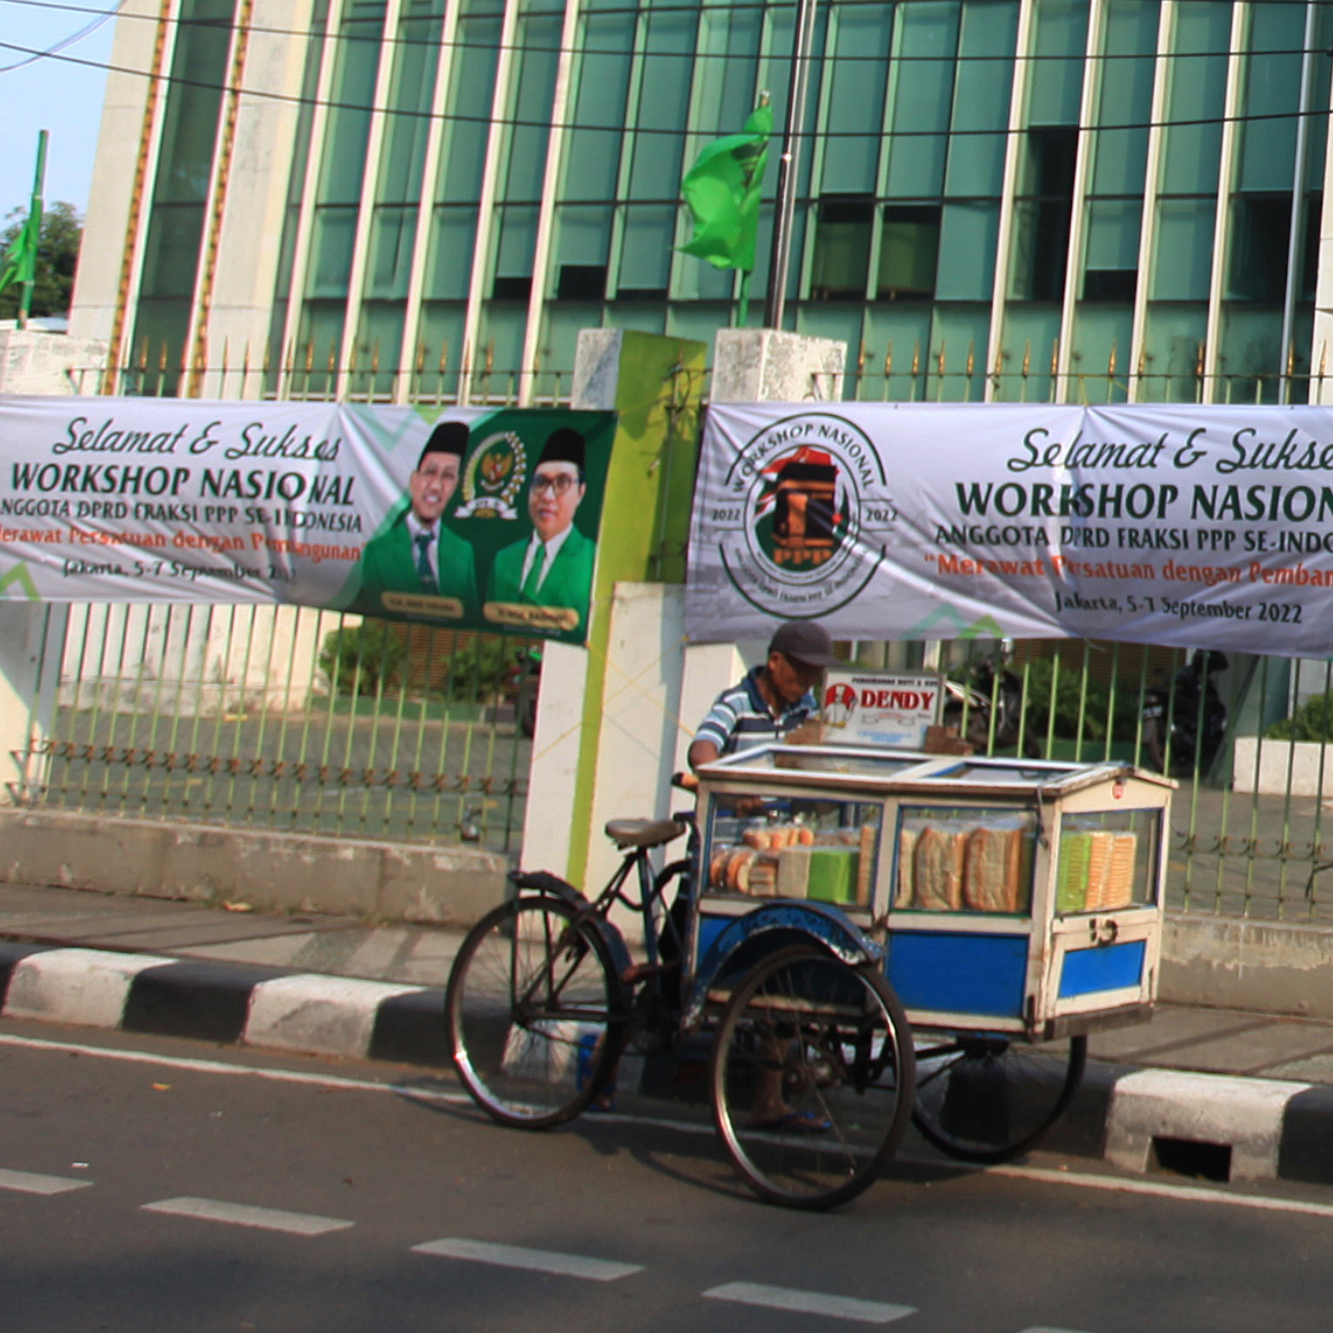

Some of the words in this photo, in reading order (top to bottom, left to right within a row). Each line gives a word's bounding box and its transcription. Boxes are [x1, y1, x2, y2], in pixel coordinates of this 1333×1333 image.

[52, 417, 190, 455] Selamat
[188, 421, 222, 454] &
[224, 422, 342, 461] Sukses
[1007, 428, 1169, 472] Selamat
[1173, 427, 1208, 468] &
[733, 424, 814, 494] WORKSHOP
[818, 424, 875, 490] NASIONAL
[12, 463, 191, 496] WORKSHOP
[200, 468, 355, 505] NASIONAL
[0, 499, 70, 517] NGGOTA
[77, 500, 128, 519] DPRD
[204, 506, 238, 523] PPP
[955, 482, 1178, 519] WORKSHOP
[0, 524, 62, 543] erawat
[173, 530, 244, 553] dengan
[935, 524, 1050, 546] ANGGOTA
[1060, 526, 1111, 548] DPRD
[1117, 527, 1189, 550] FRAKSI
[1197, 529, 1236, 551] PPP
[773, 548, 832, 565] PPP
[1162, 560, 1242, 587] dengan
[1055, 591, 1123, 613] Jakarta,
[1127, 595, 1156, 613] 5-7
[1161, 597, 1252, 620] September
[1258, 602, 1302, 624] 2022
[860, 689, 935, 710] DENDY
